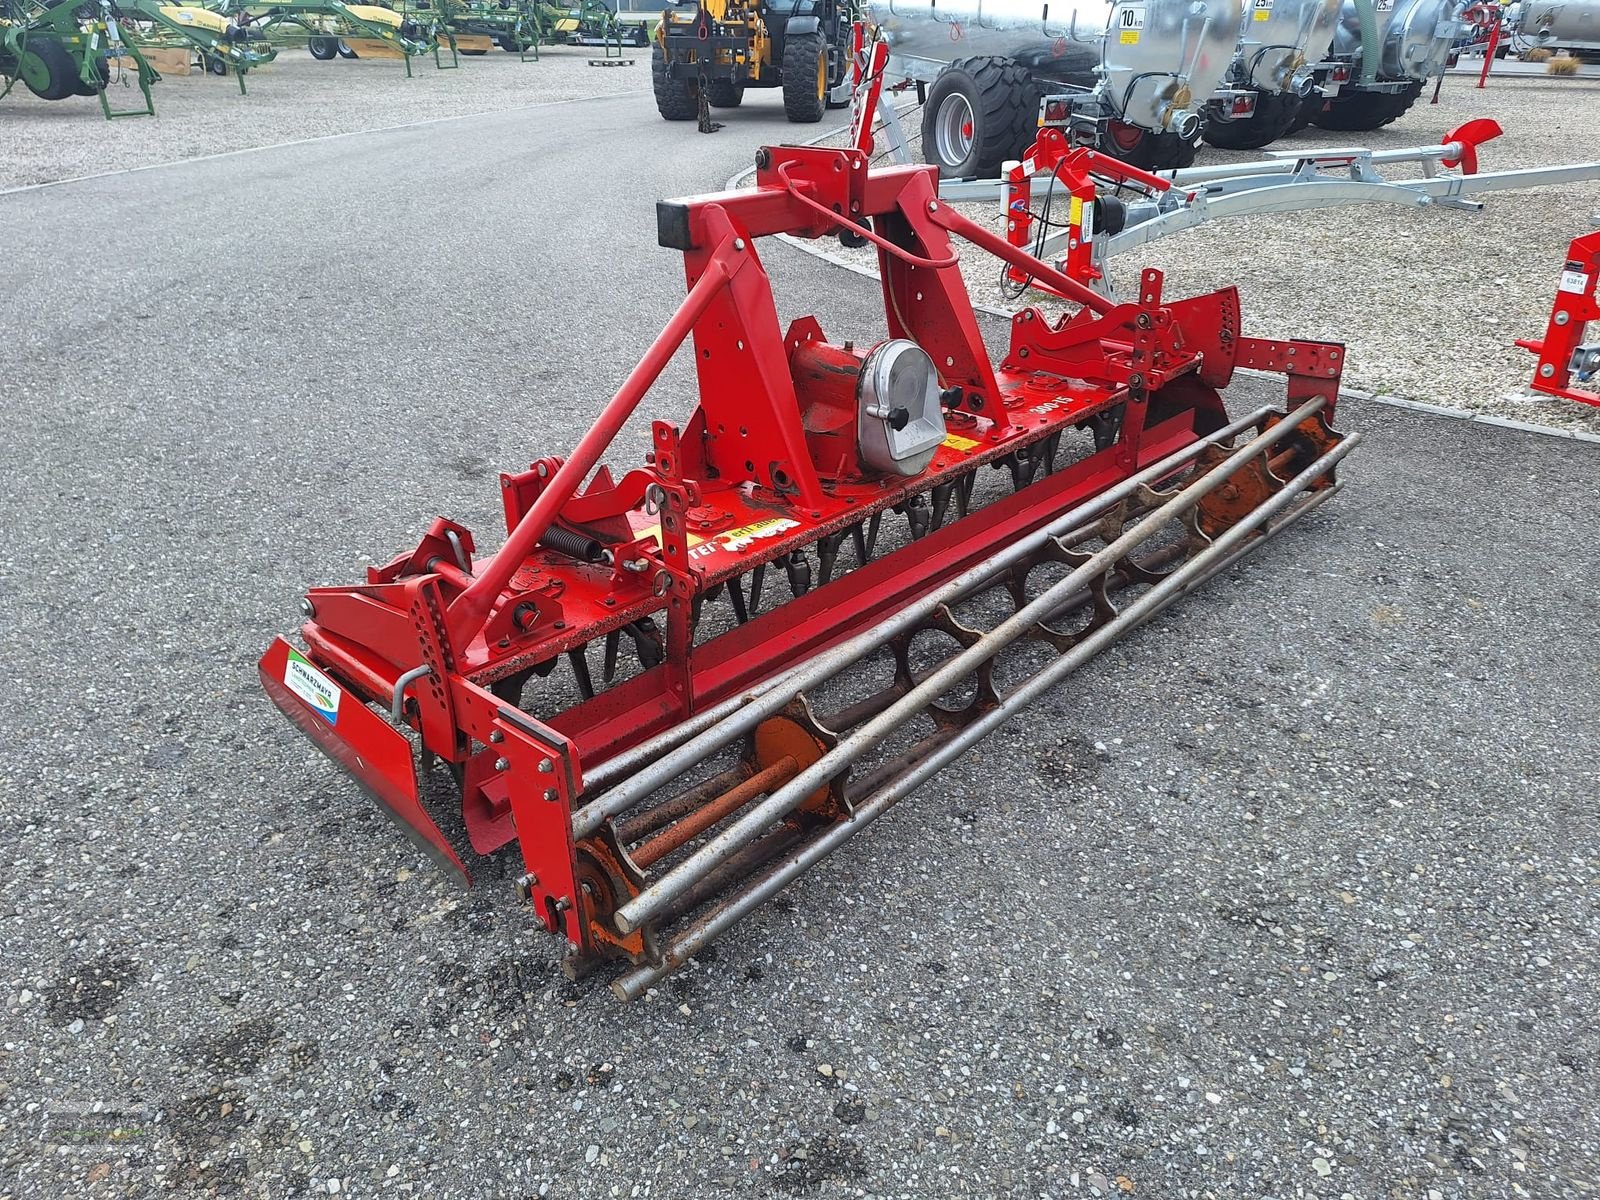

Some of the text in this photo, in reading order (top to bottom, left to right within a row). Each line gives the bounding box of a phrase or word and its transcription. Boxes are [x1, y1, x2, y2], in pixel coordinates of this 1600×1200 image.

[1378, 0, 1387, 10] 25
[1122, 10, 1134, 27] 10
[1029, 396, 1075, 414] 300-15
[292, 661, 332, 698] SCHWARZMAYR
